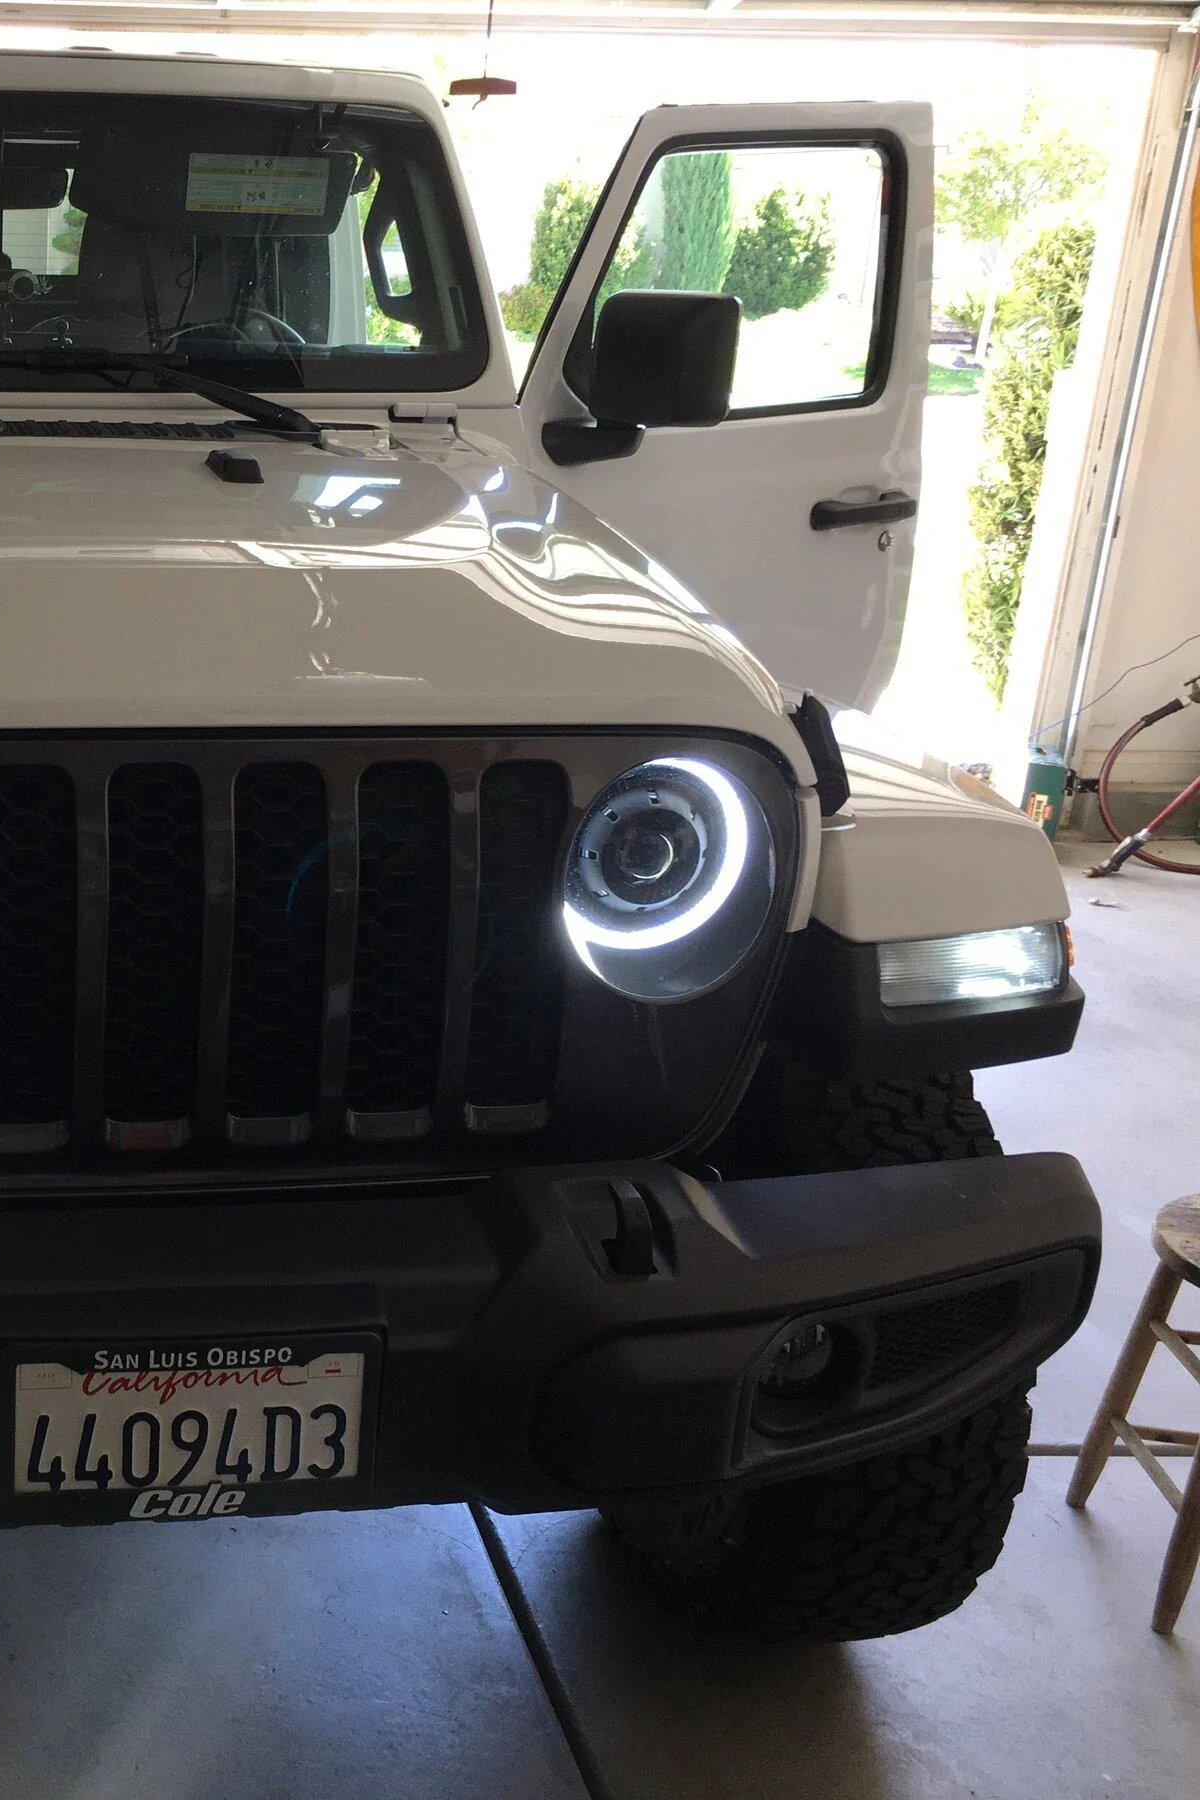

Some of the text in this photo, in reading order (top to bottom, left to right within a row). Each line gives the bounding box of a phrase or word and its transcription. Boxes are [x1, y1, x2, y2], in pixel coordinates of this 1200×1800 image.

[94, 1346, 292, 1370] SAN LUIS OBISPO
[82, 1367, 308, 1405] California
[27, 1404, 347, 1491] 44094D3
[129, 1480, 246, 1518] Cole
